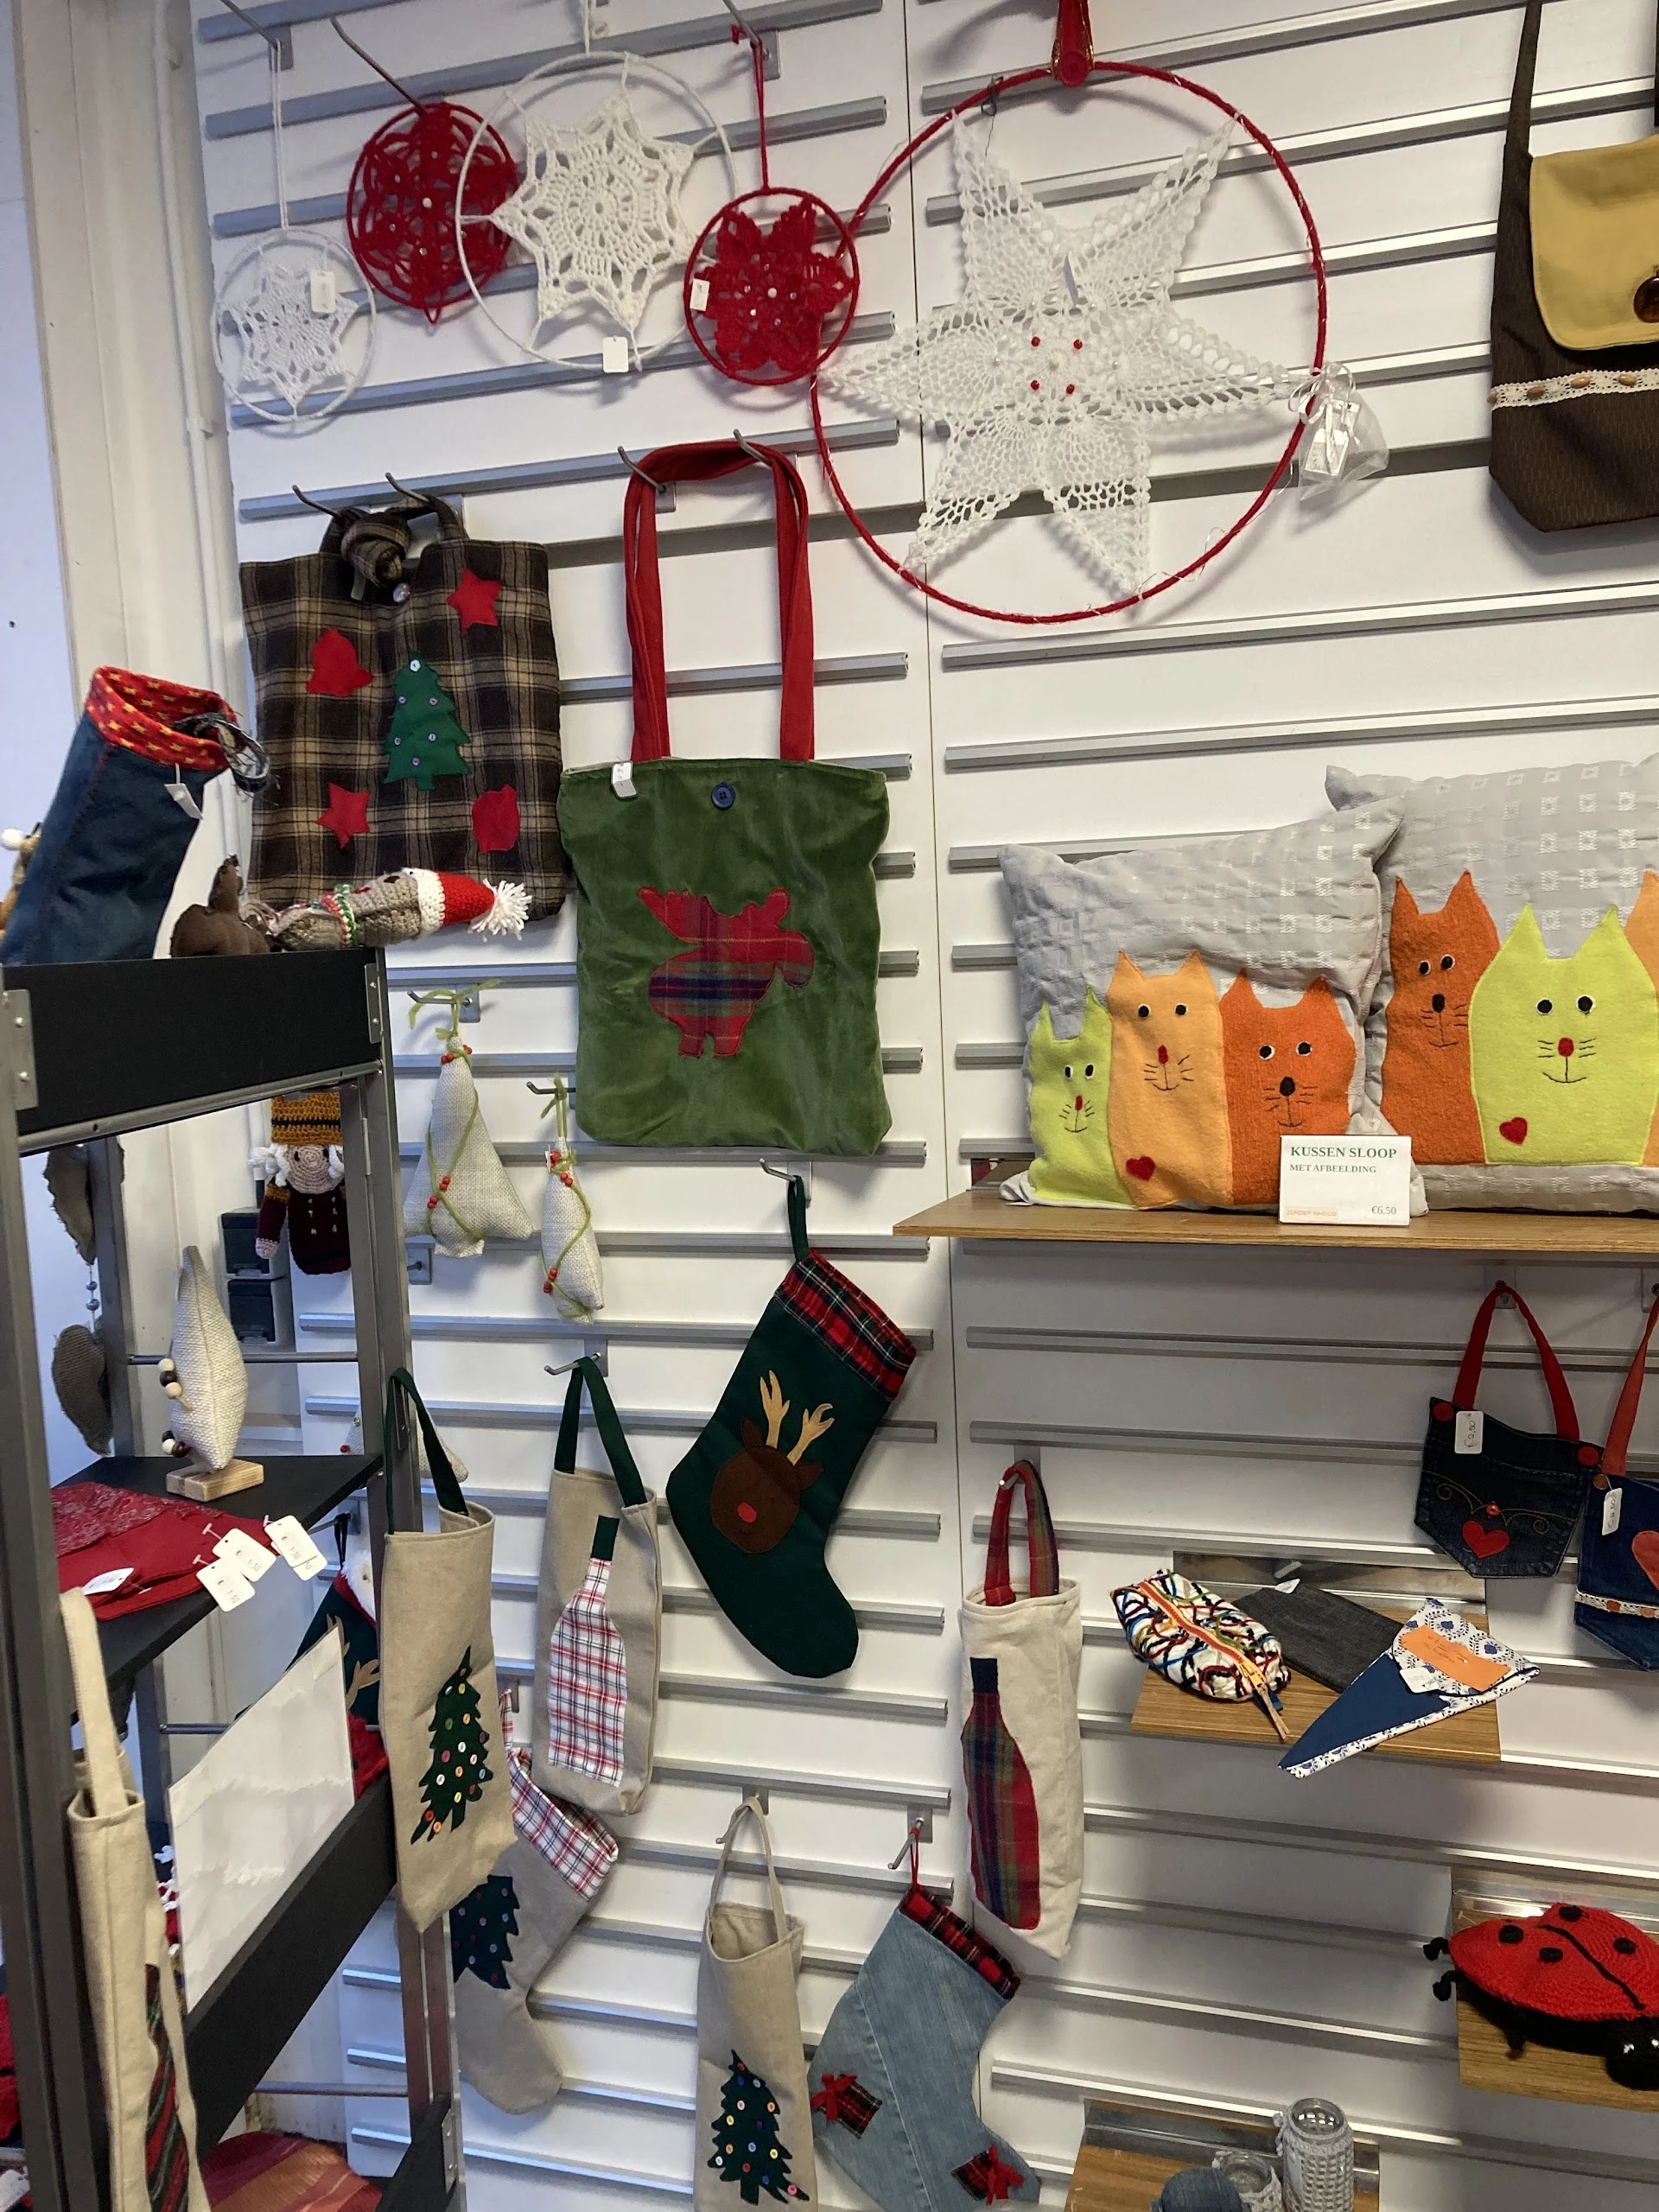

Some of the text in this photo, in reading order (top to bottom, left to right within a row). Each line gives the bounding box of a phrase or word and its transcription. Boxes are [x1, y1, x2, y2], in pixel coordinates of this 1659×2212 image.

[1290, 1147, 1397, 1159] KUSSEN SLOOP
[1289, 1164, 1377, 1173] MET AFBEELDING
[1371, 1205, 1396, 1215] €6,50
